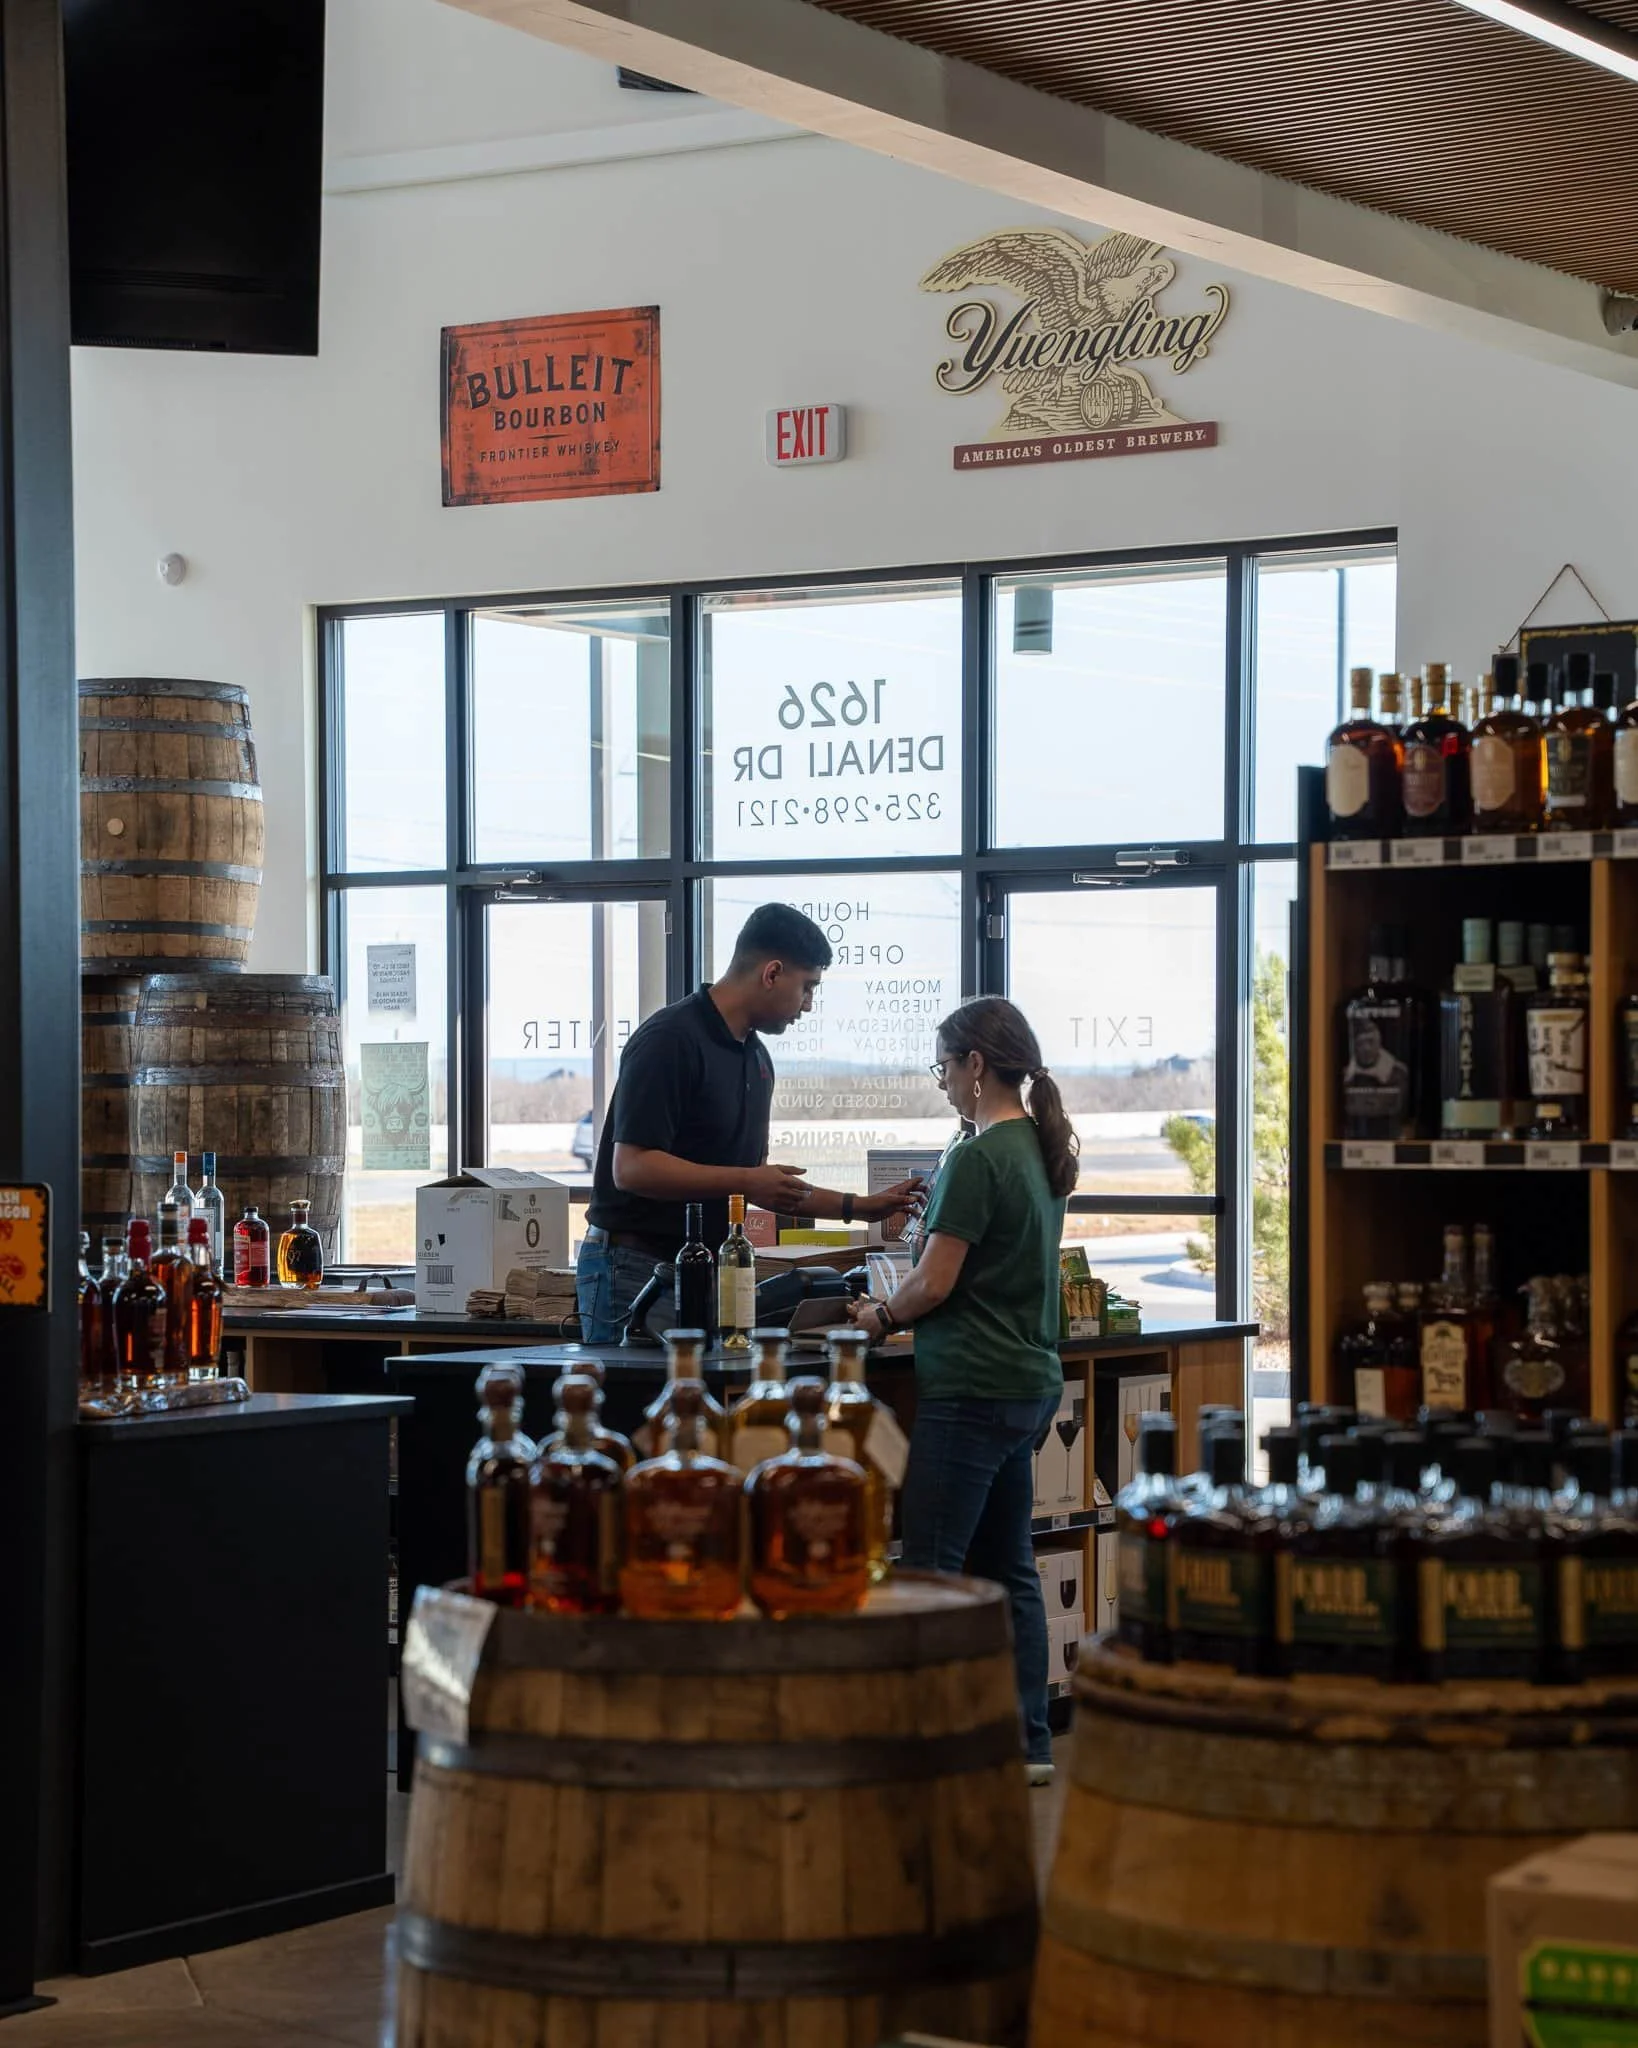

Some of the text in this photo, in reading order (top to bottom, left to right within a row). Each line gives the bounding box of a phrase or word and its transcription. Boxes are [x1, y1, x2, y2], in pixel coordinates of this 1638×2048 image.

[936, 284, 1230, 393] Yuengling
[466, 354, 635, 410] BULLEIT
[494, 401, 607, 431] BOURBON
[776, 406, 829, 460] EXIT
[479, 439, 620, 464] FRONTIER WHISKEY
[961, 429, 1206, 463] AMERICA'S OLDEST BREWERY
[0, 1191, 20, 1205] ASH
